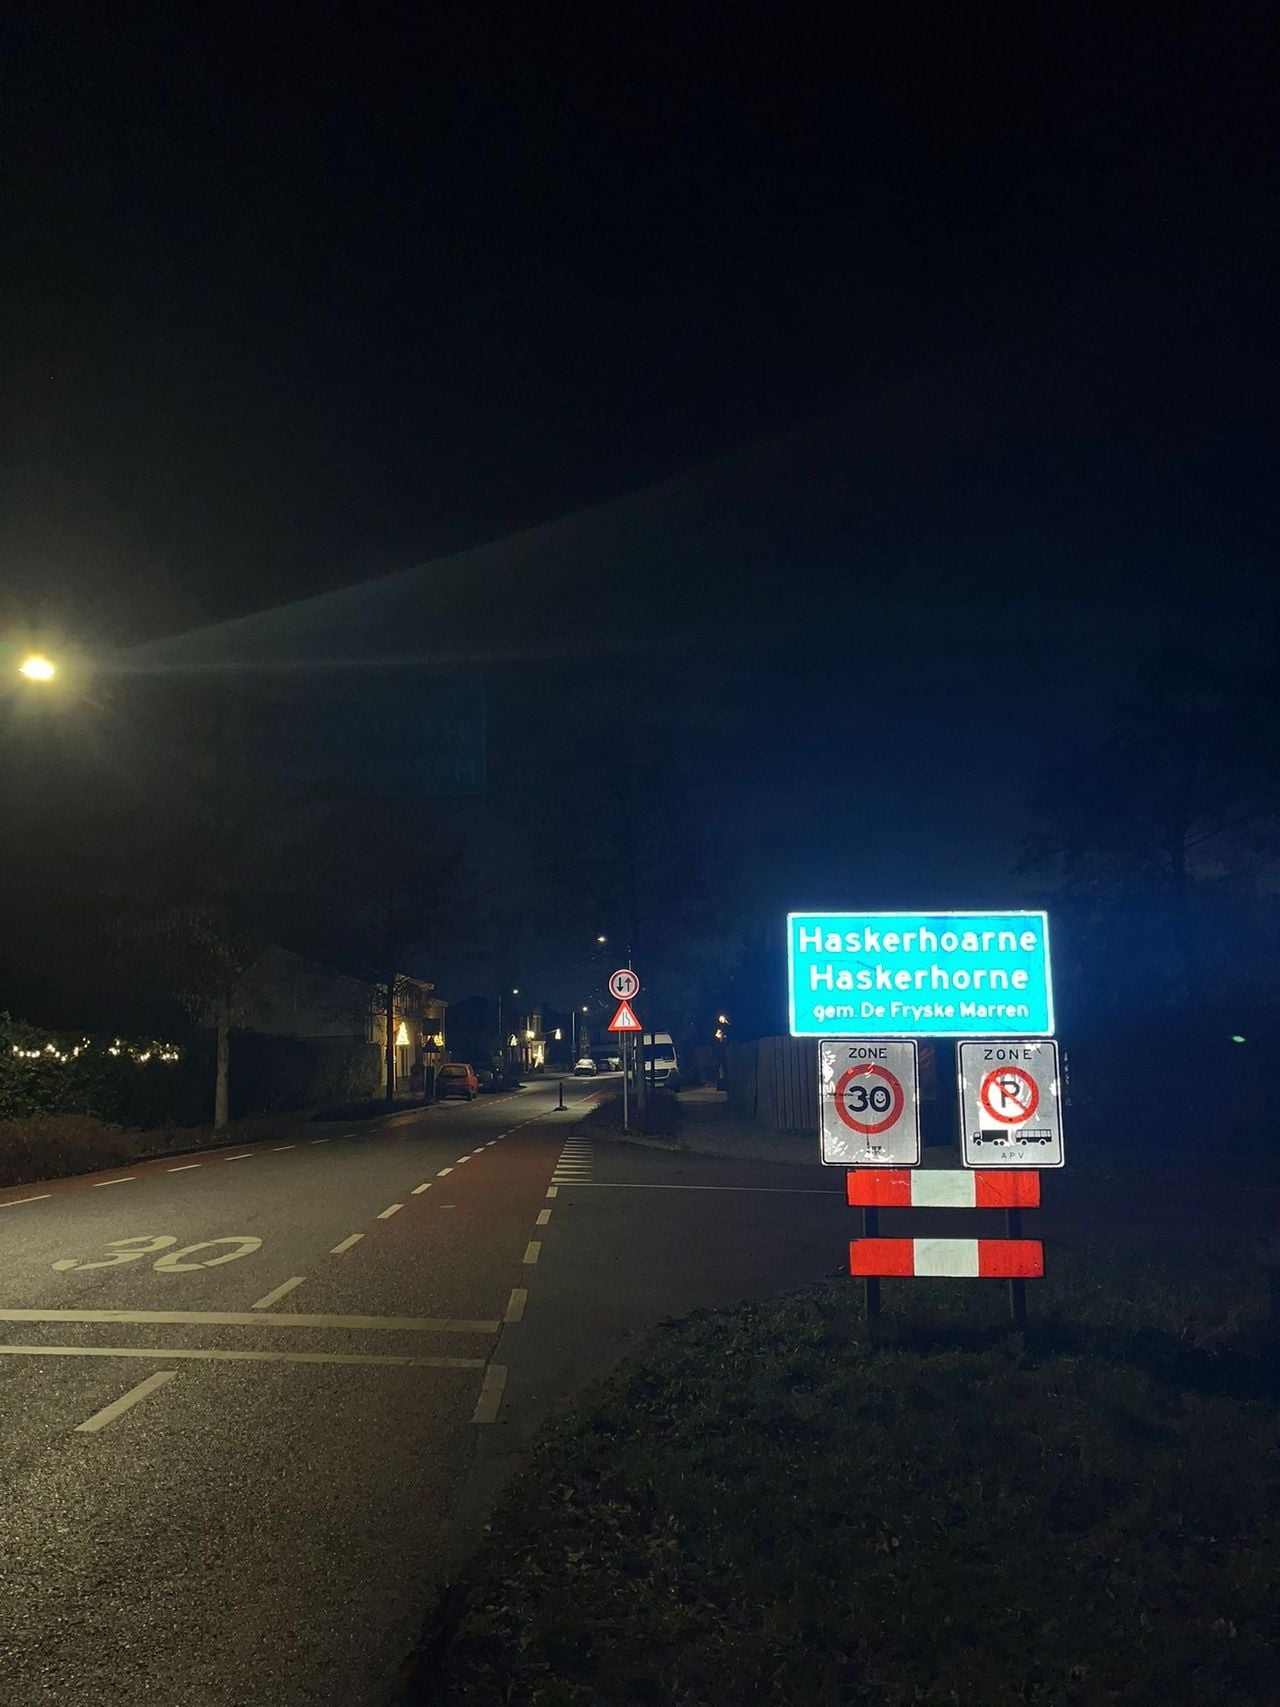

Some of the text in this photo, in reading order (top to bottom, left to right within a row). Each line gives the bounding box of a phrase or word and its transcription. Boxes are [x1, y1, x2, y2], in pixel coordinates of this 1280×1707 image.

[799, 926, 1037, 953] Haskerhoarne
[810, 964, 1029, 990] Haskerhorne
[861, 1002, 885, 1018] De
[890, 1001, 955, 1021] Fryske
[960, 1002, 1029, 1018] Marren
[848, 1048, 888, 1059] ZONE
[984, 1049, 1033, 1060] ZONE
[848, 1085, 891, 1113] 30
[51, 1235, 262, 1272] 30
